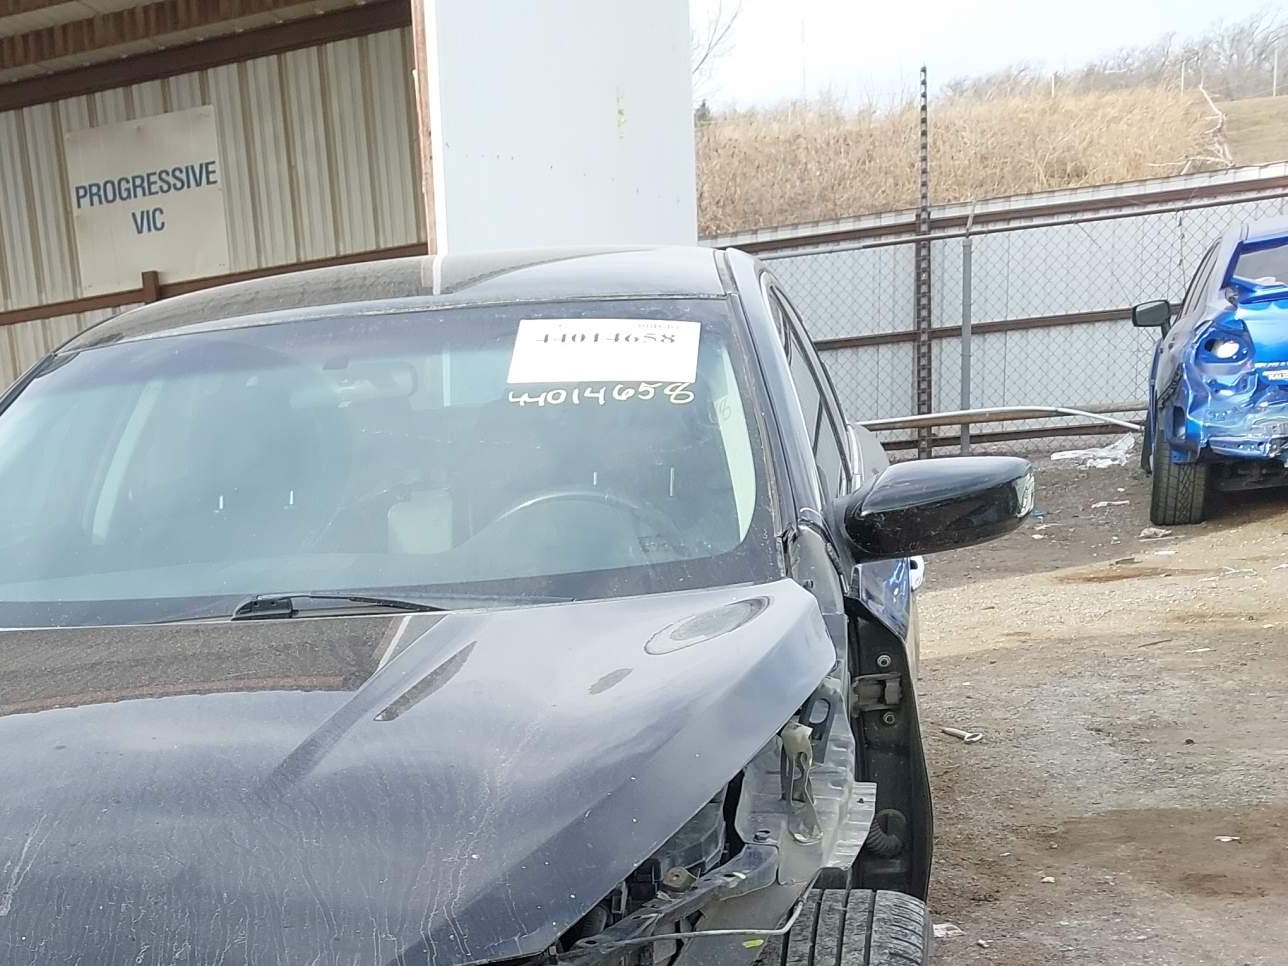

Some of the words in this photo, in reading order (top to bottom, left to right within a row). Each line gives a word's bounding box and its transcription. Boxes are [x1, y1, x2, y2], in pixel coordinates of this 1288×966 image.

[75, 161, 218, 208] PROGRESSIVE
[132, 208, 165, 234] VIC
[508, 382, 695, 407] 44014658
